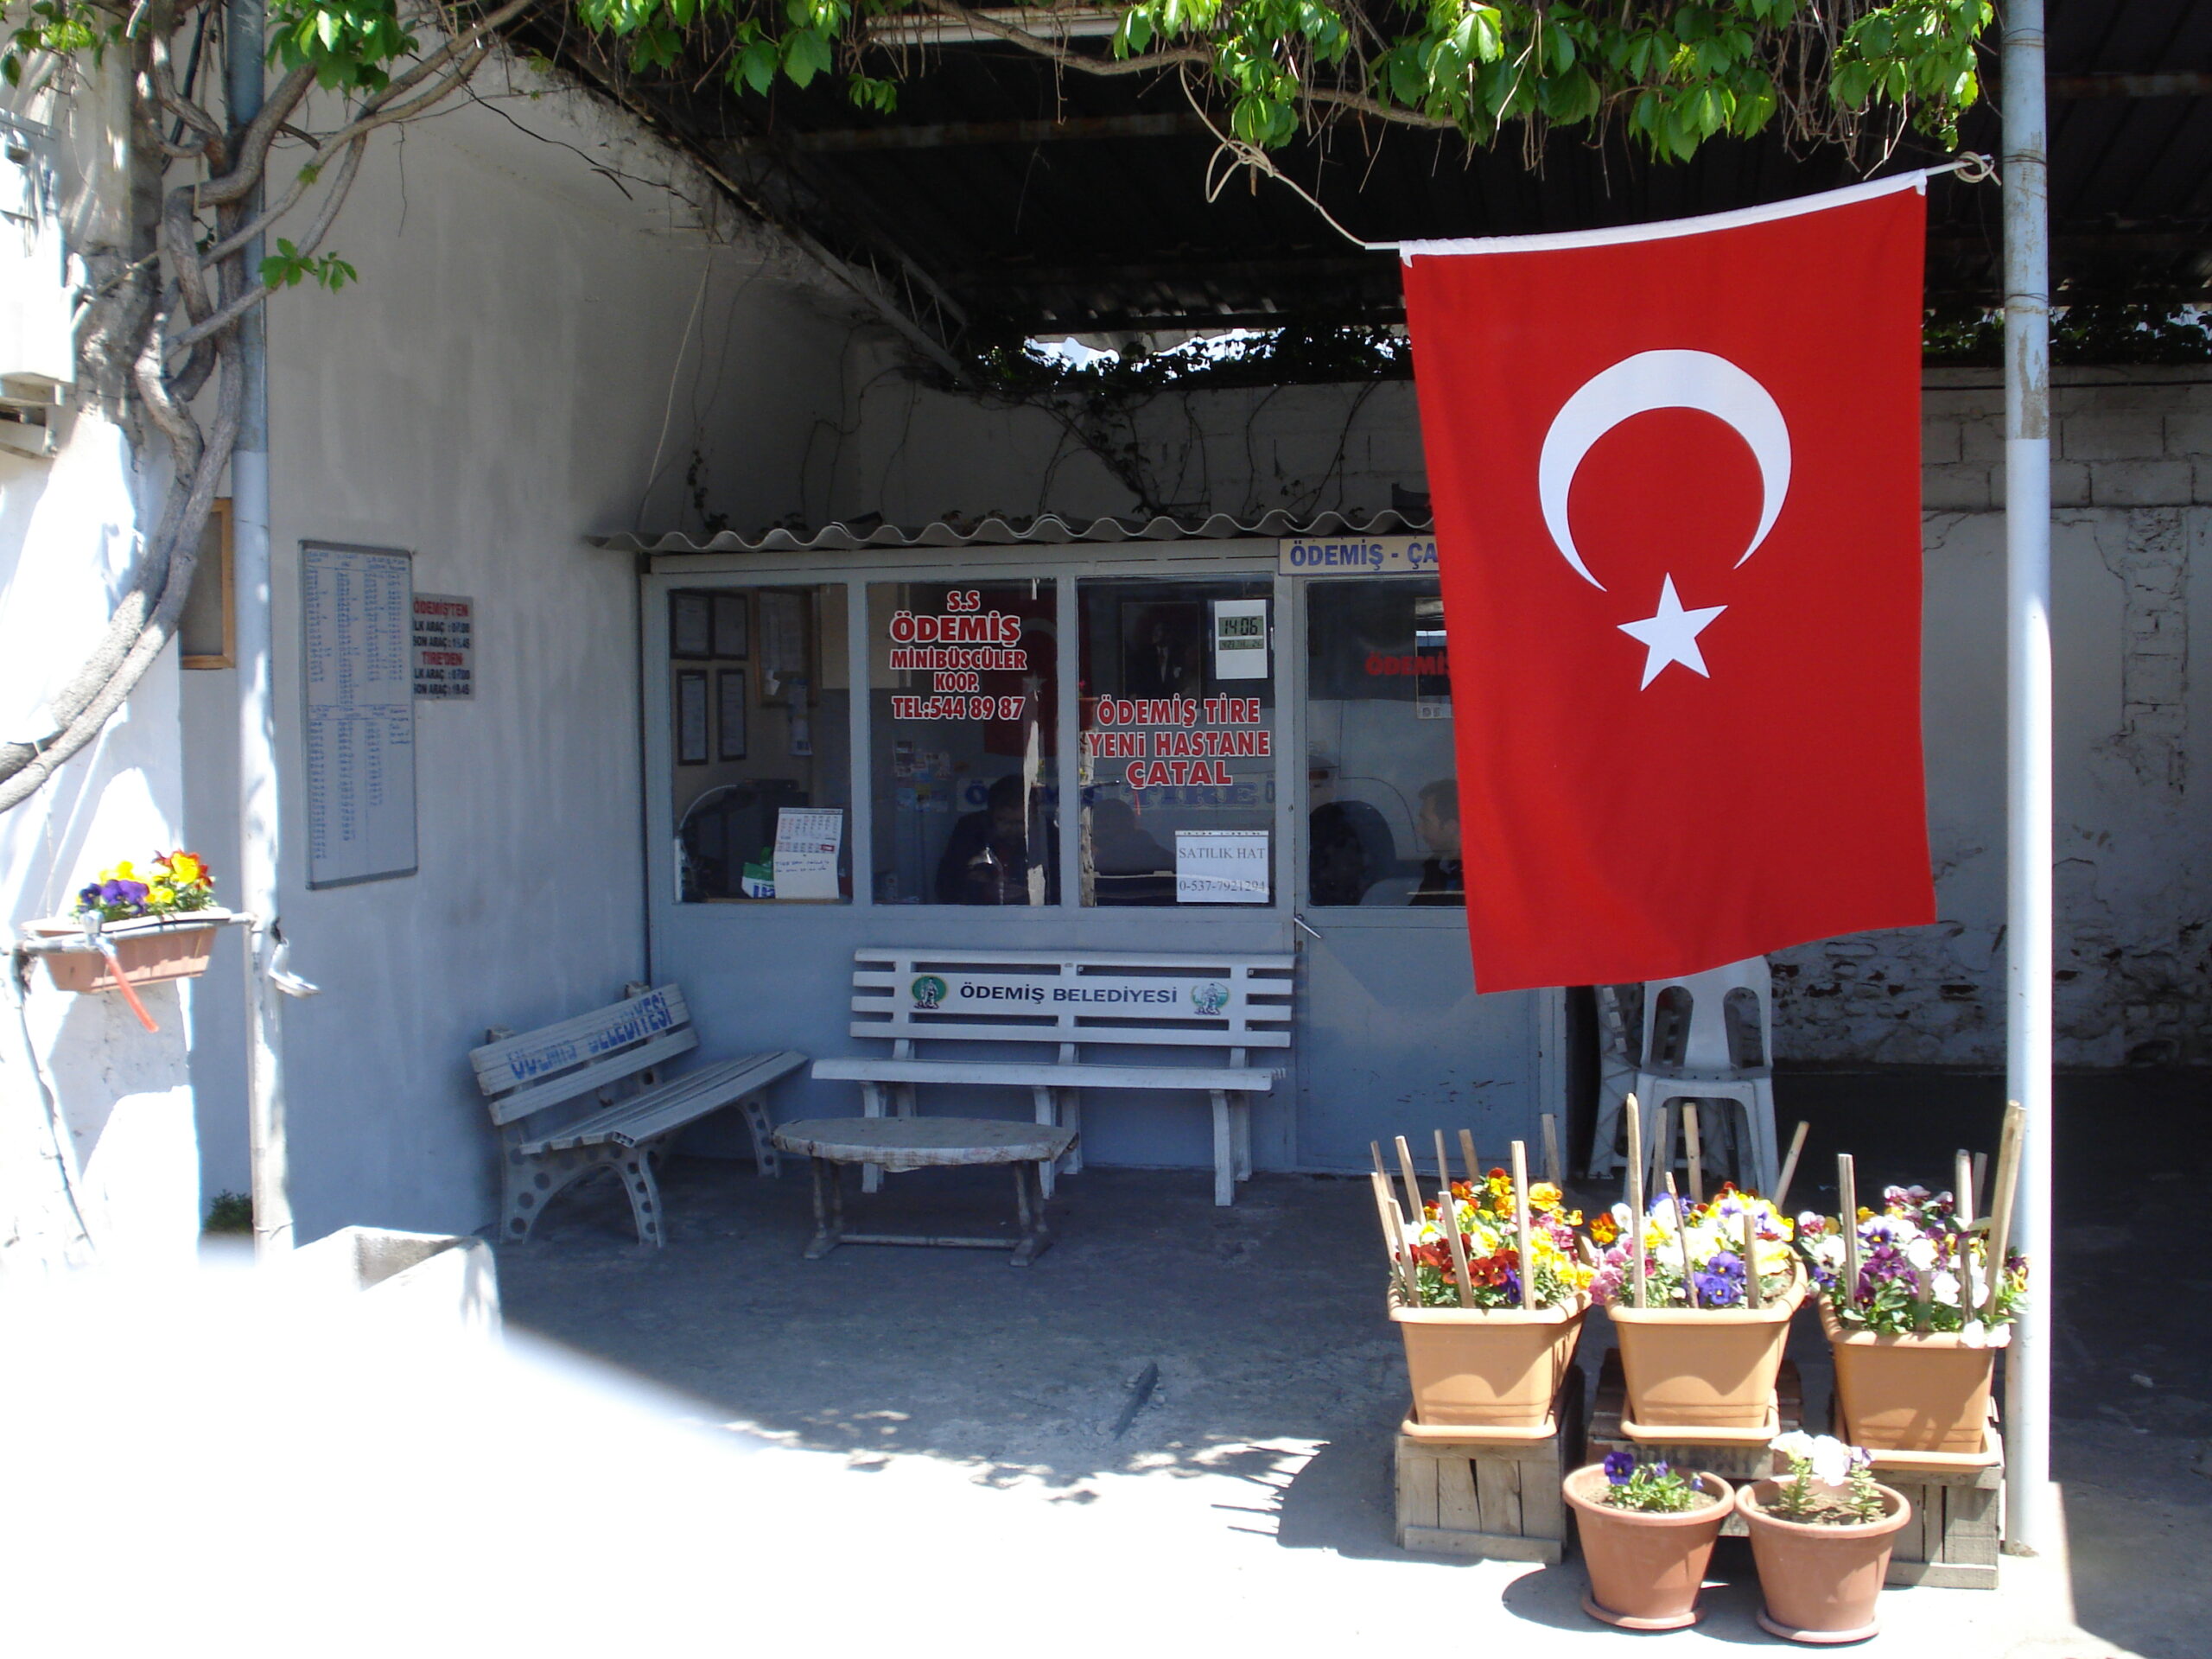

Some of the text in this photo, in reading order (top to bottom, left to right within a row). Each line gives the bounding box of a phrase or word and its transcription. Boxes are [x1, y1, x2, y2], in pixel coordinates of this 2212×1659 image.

[1290, 539, 1384, 571] ÖDEMİŞ
[947, 590, 981, 612] S.S
[890, 610, 1021, 647] ÖDEMİŞ
[890, 645, 1028, 671] MİNİBÜSCÜLER
[1365, 651, 1449, 676] ÖDEMİ
[934, 671, 981, 693] KOOP.
[969, 695, 995, 721] 89
[998, 695, 1027, 720] 87
[1096, 692, 1261, 728] ÖDEMİŞ TİRE
[1154, 730, 1271, 758] HASTANE
[1126, 760, 1233, 791] ÇATAL
[1179, 847, 1266, 860] SATILIK HAT
[959, 981, 1178, 1005] ÖDEMİŞ BELEDİYESİ
